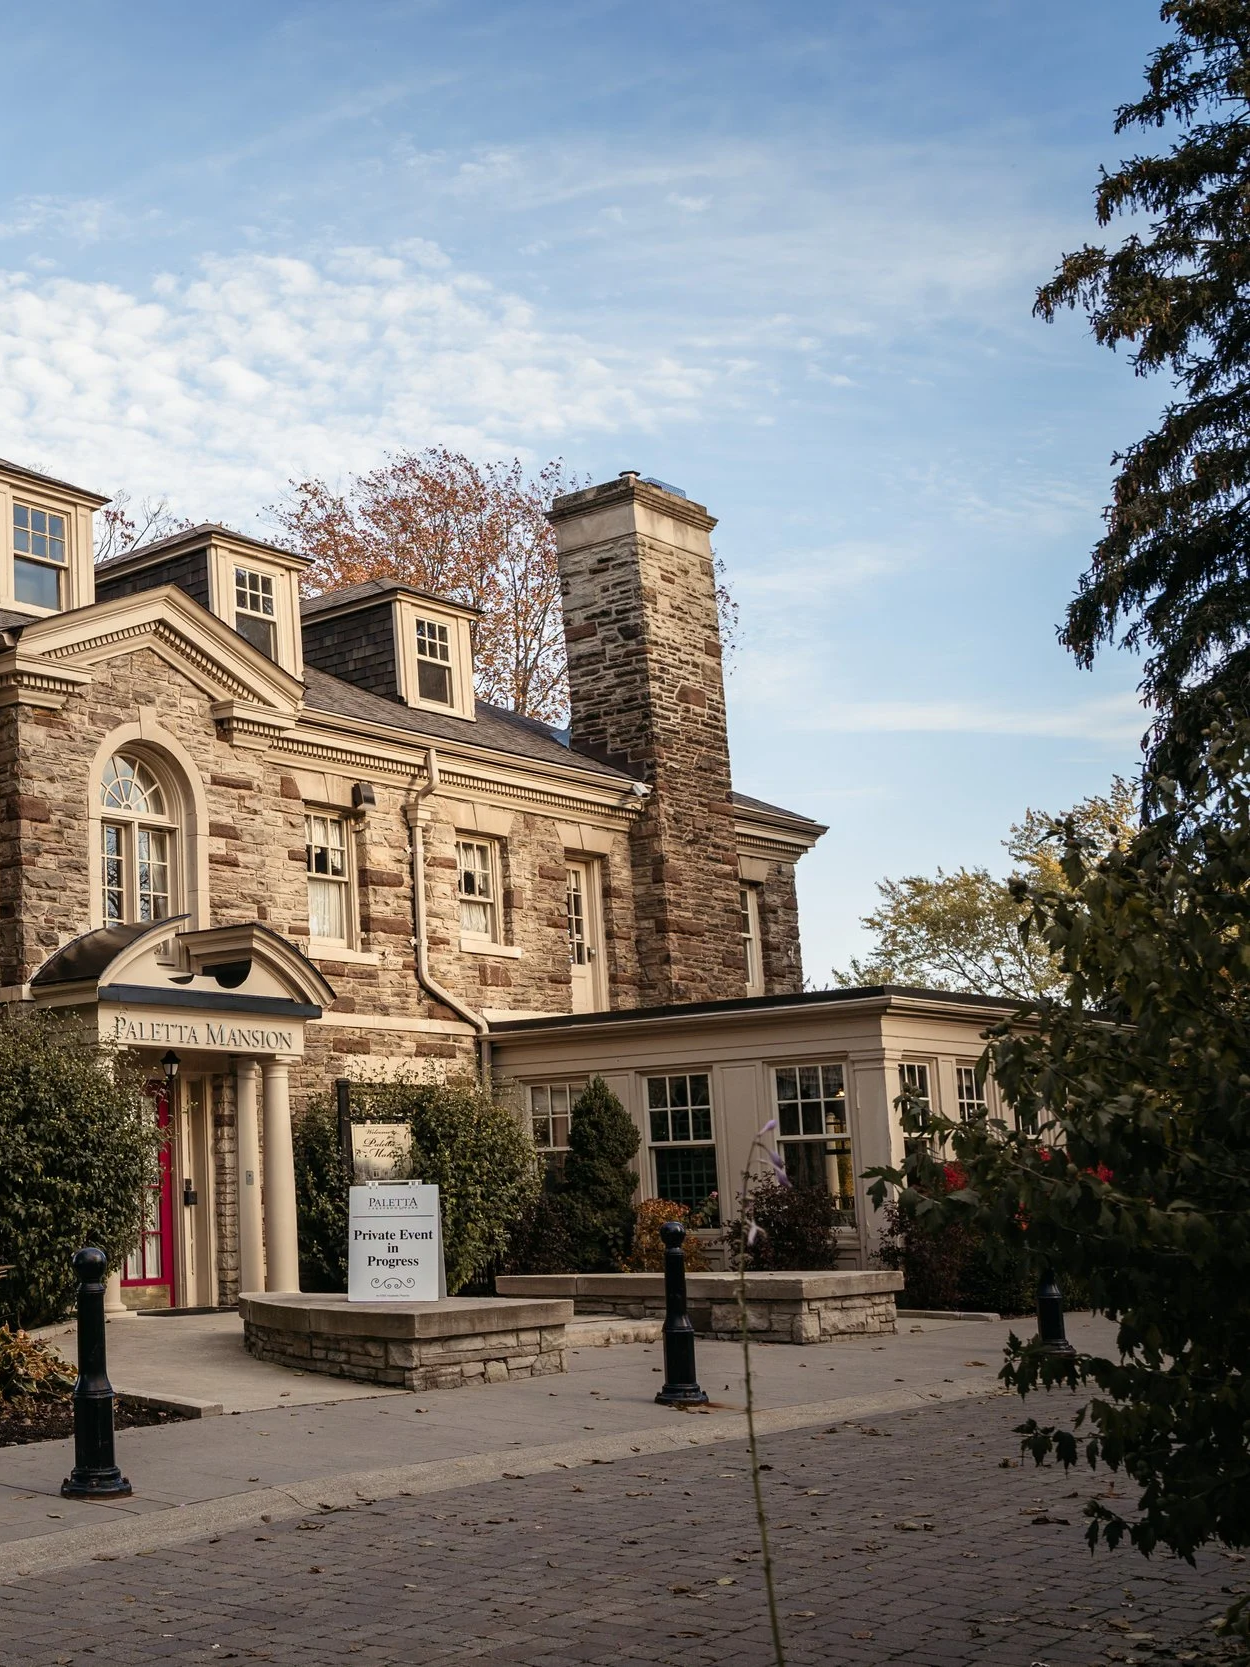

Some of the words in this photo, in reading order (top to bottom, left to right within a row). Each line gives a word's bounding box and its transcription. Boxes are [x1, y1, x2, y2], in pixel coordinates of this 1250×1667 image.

[114, 1016, 199, 1044] PALETTA
[206, 1023, 293, 1049] MANSION
[368, 1197, 418, 1207] PALETTA
[353, 1229, 396, 1241] Private
[400, 1229, 433, 1241] Event
[387, 1242, 399, 1254] in
[367, 1256, 419, 1269] Progress
